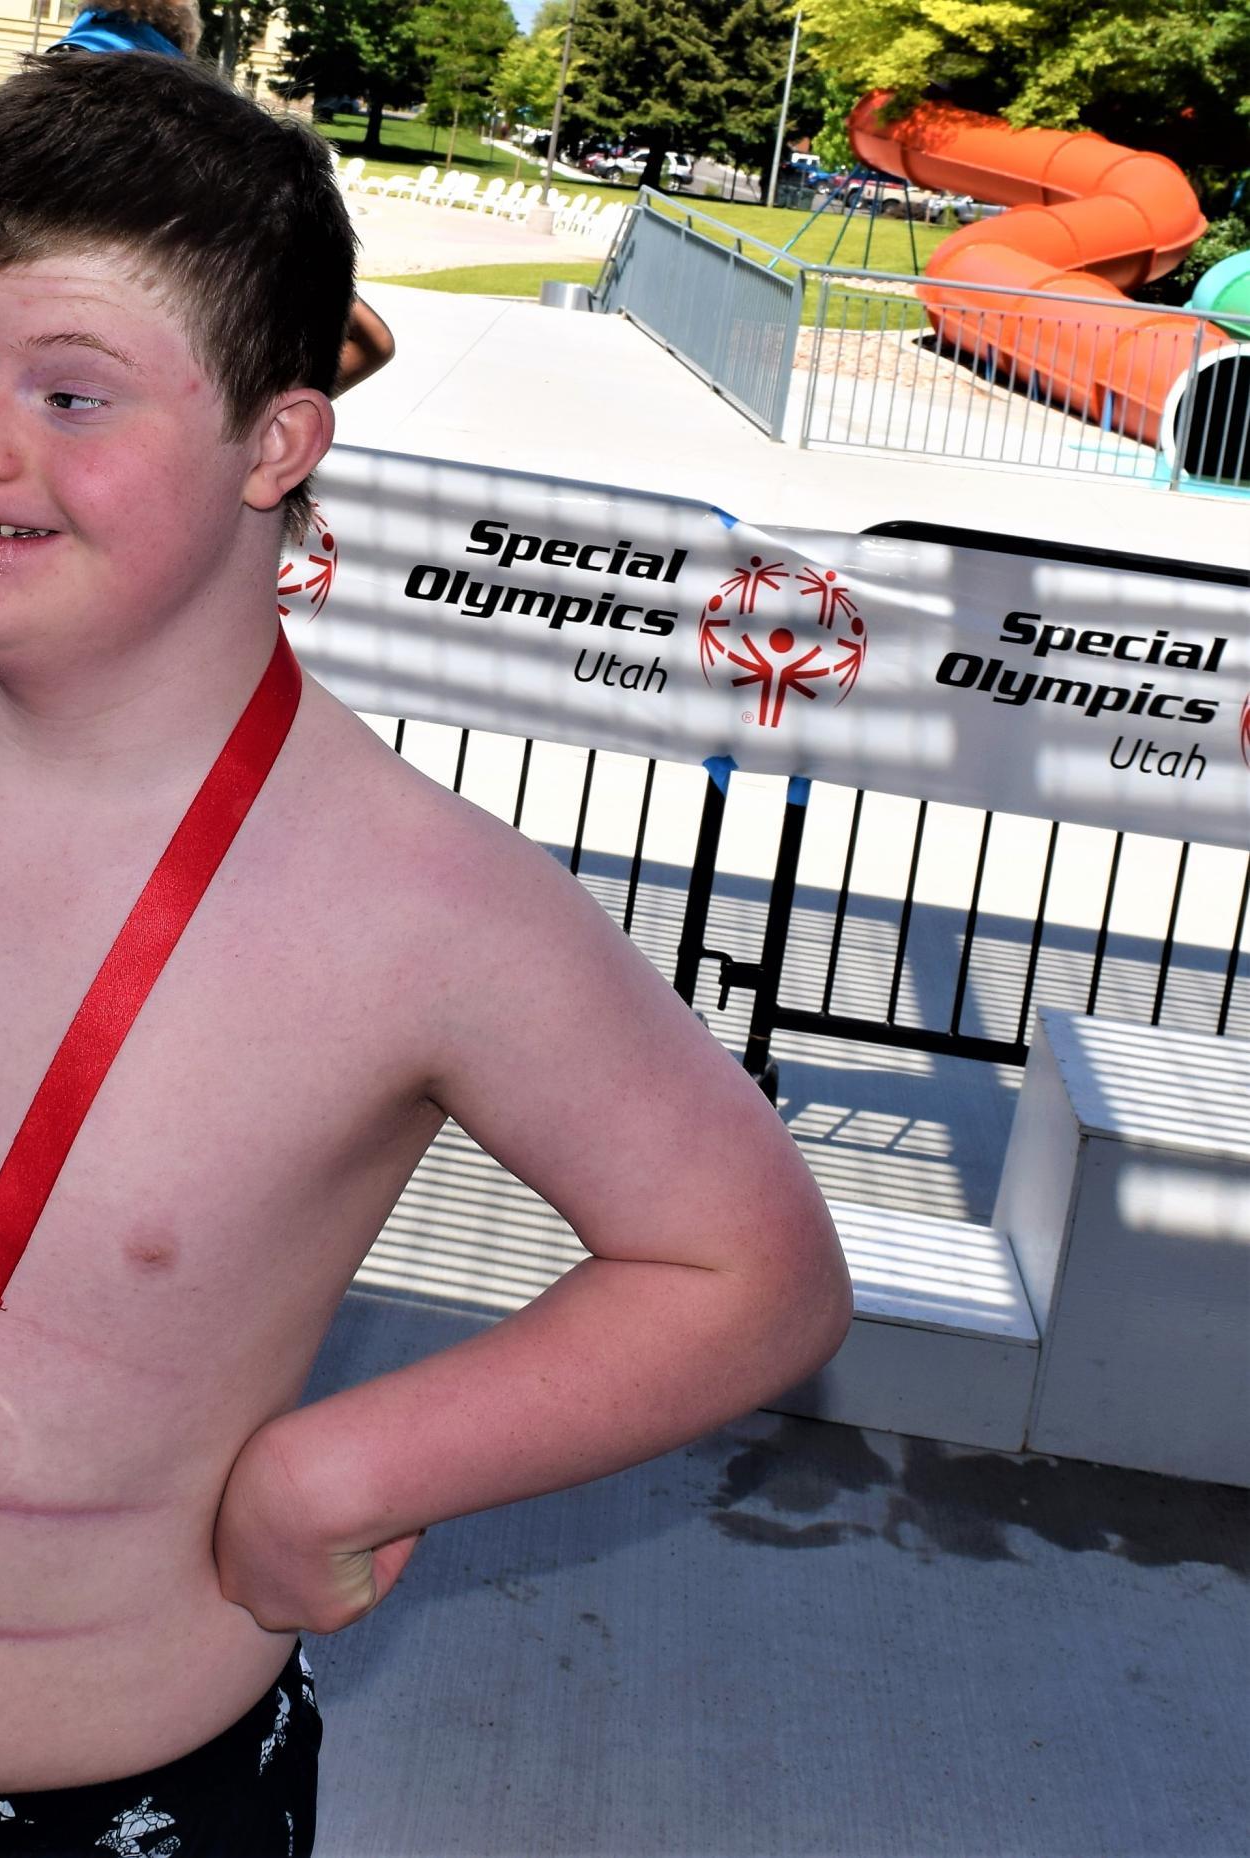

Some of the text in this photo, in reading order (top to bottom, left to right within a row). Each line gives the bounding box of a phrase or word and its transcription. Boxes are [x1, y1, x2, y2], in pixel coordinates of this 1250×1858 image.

[465, 519, 689, 584] Special
[404, 574, 679, 637] Olympics
[573, 649, 669, 694] Utah
[999, 611, 1229, 673] Special
[935, 652, 1220, 725] Olympics
[1109, 736, 1208, 781] Utah
